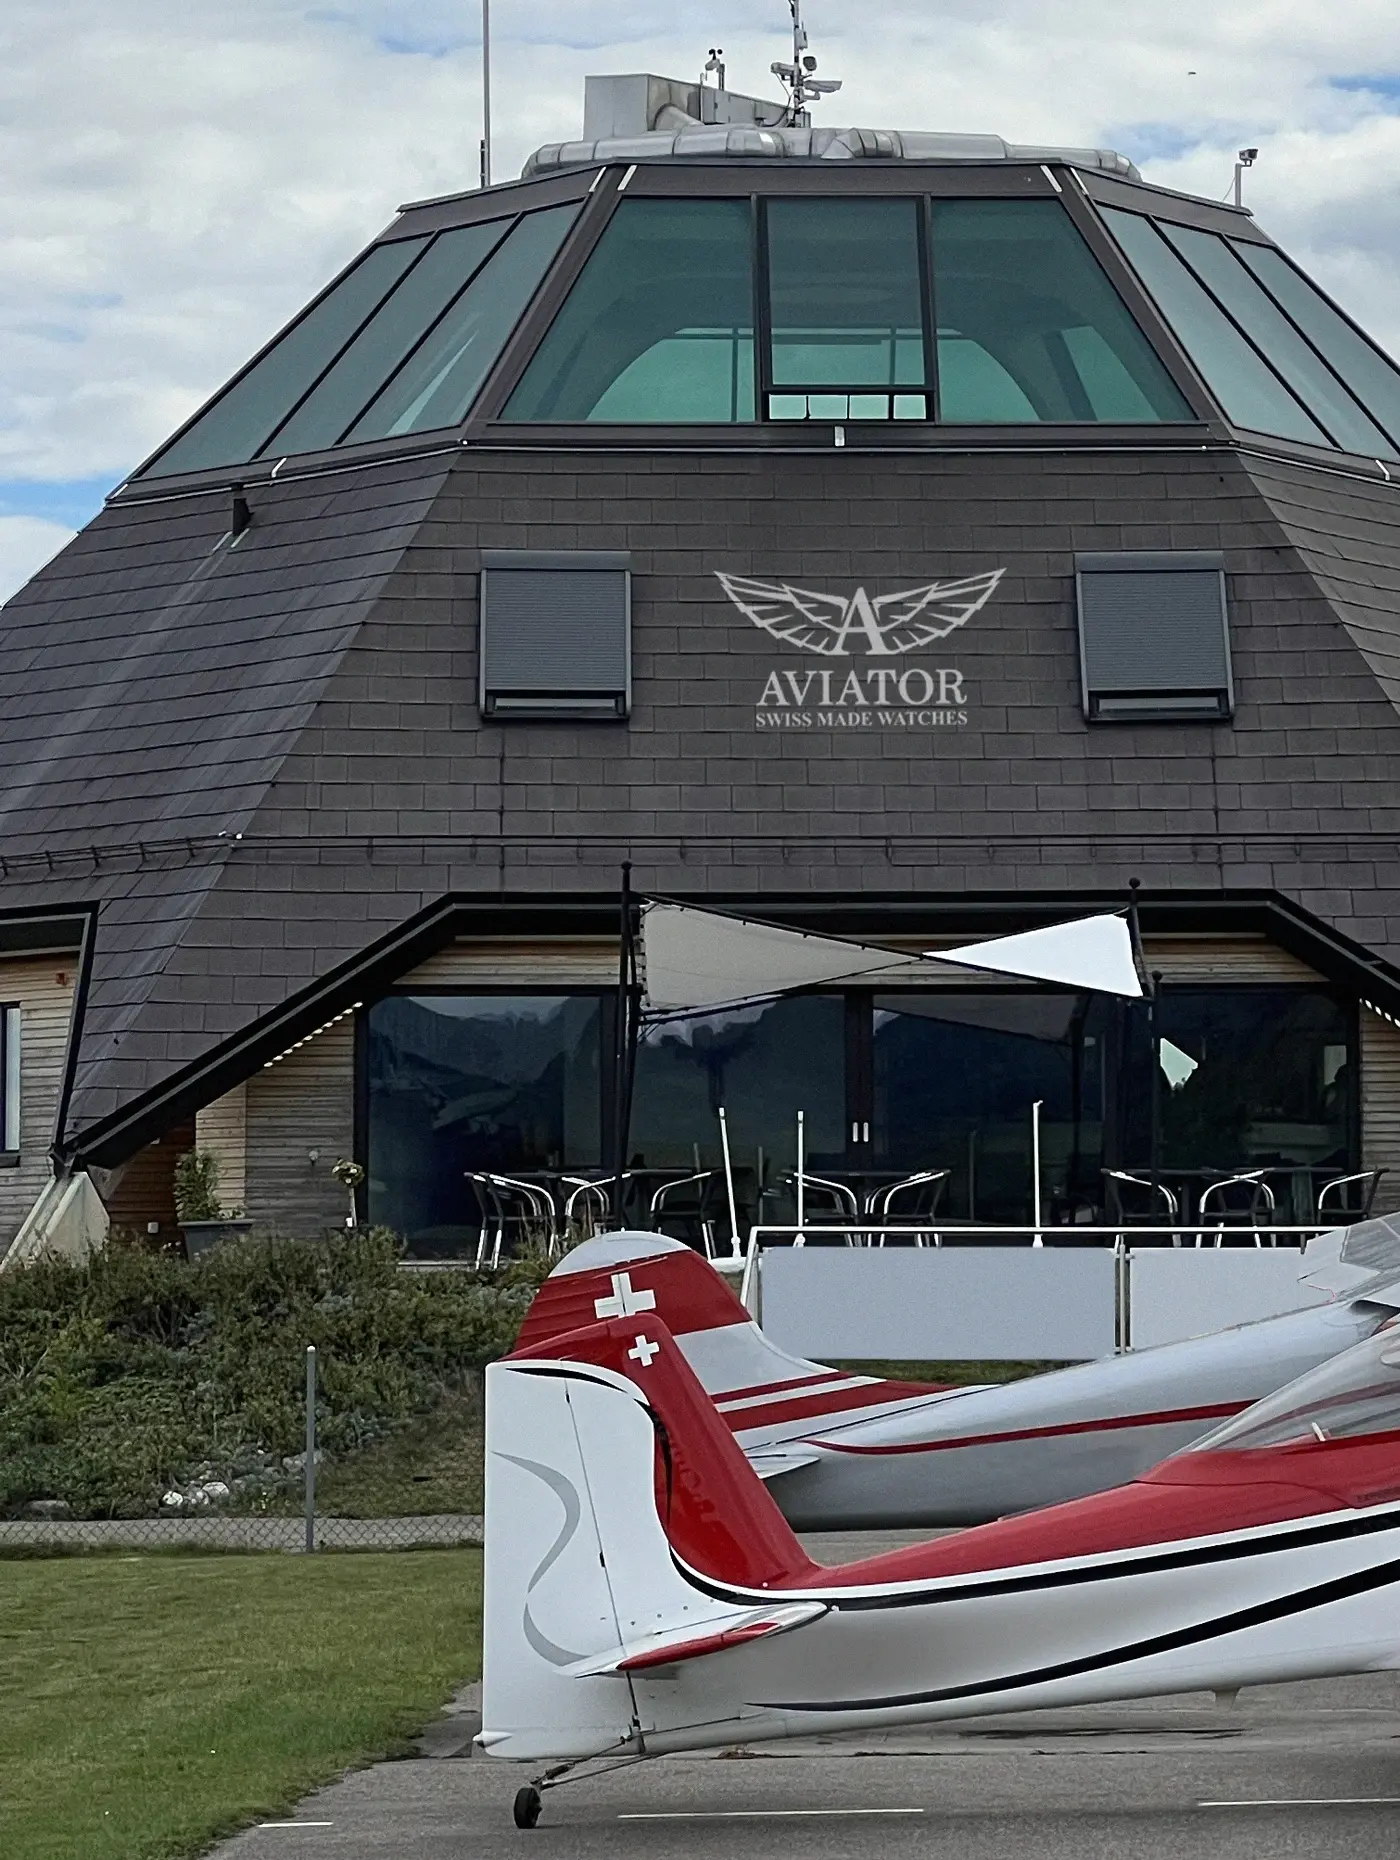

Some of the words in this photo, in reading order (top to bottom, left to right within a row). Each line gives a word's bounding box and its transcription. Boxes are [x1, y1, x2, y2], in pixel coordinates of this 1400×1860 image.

[756, 669, 967, 706] AVIATOR
[756, 712, 812, 728] SWISS
[817, 711, 872, 727] MADE
[877, 710, 968, 726] WATCHES
